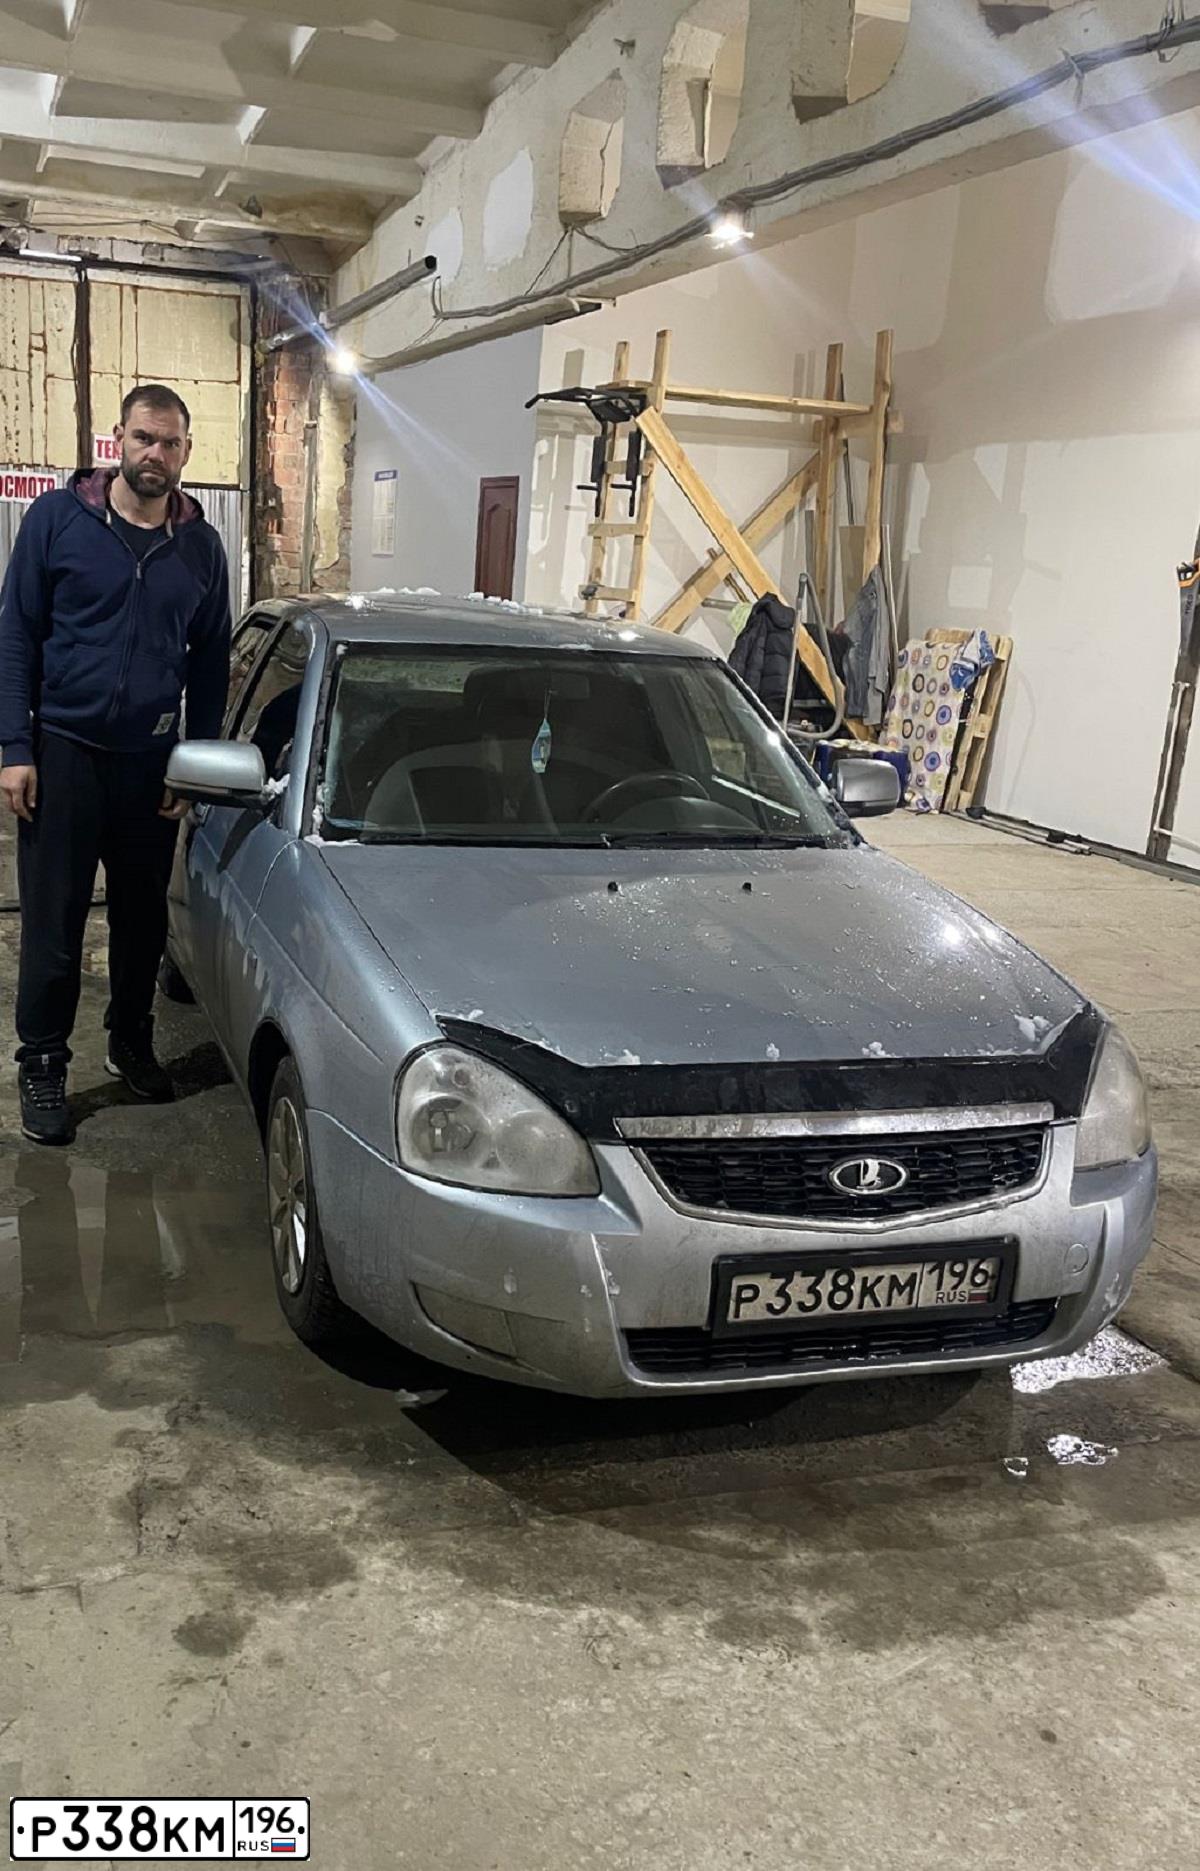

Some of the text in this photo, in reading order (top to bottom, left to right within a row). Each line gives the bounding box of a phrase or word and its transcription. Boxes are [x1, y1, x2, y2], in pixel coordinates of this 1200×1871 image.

[732, 1258, 990, 1320] Р338КМ 196
[935, 1289, 968, 1305] RUS
